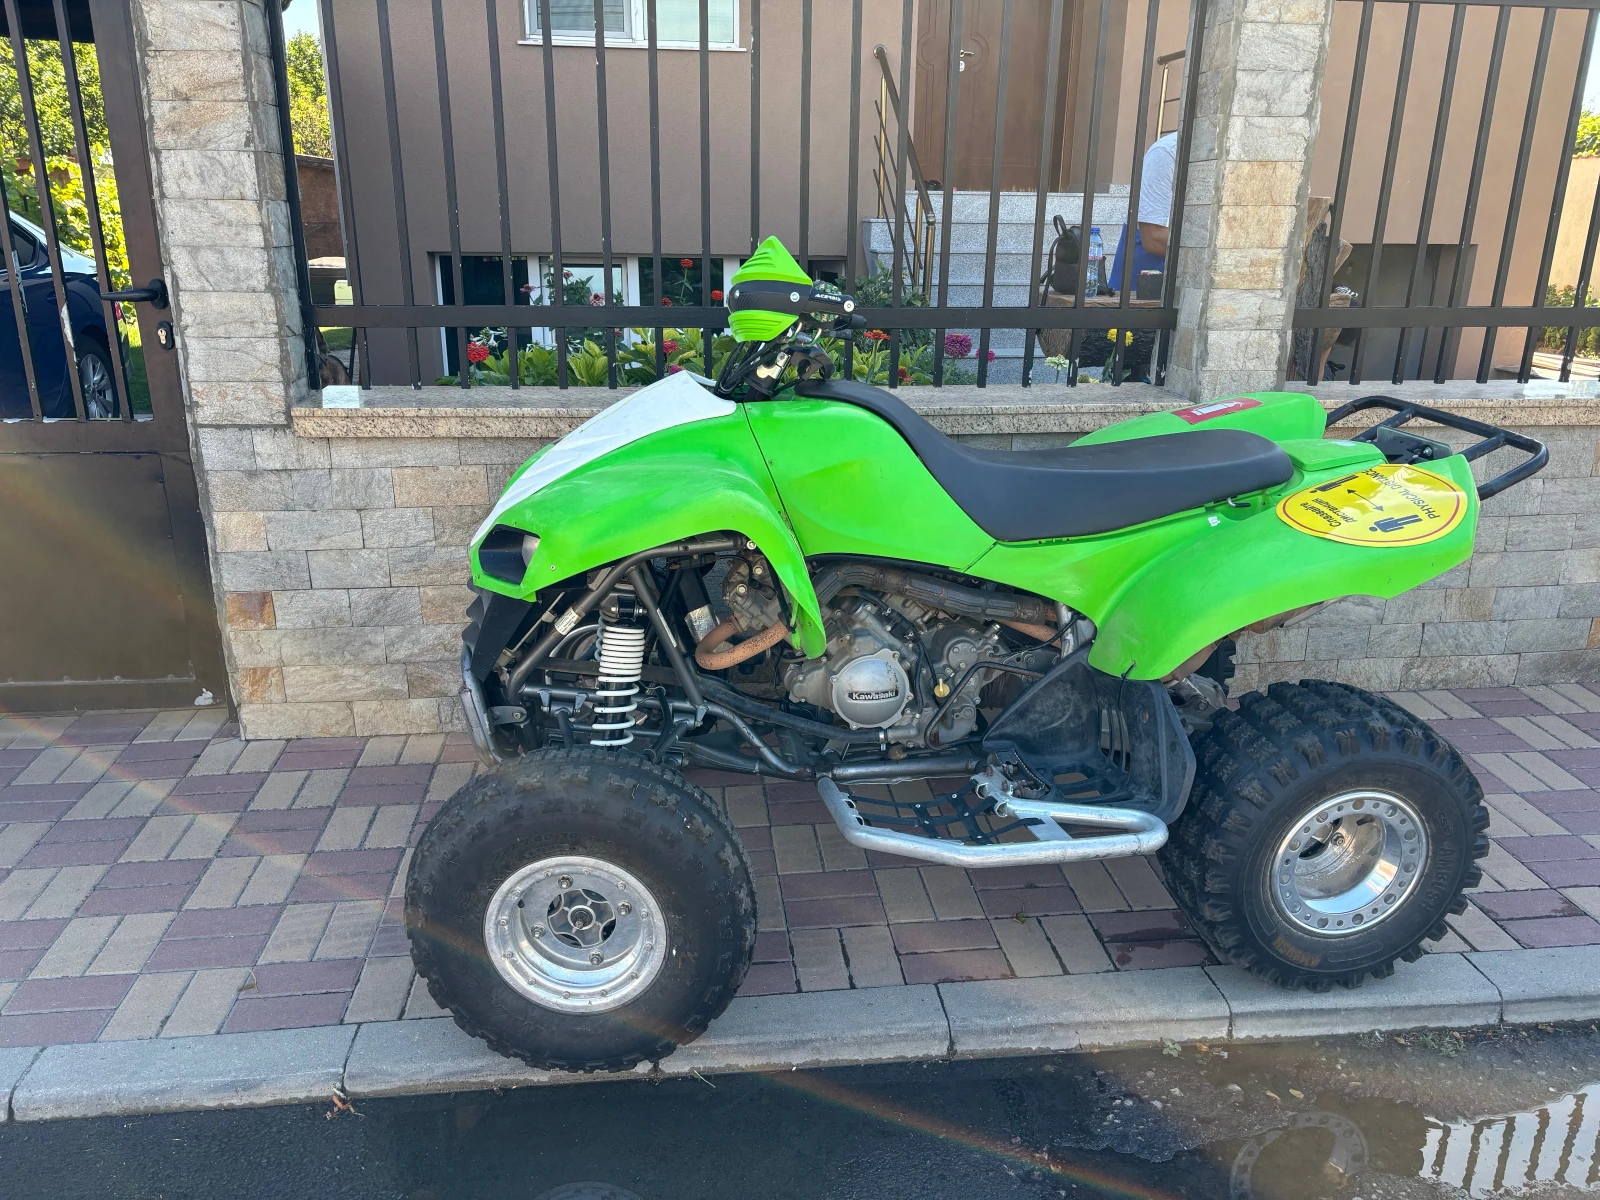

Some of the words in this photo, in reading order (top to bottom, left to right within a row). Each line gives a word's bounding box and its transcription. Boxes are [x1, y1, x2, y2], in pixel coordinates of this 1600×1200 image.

[1300, 502, 1341, 527] Спазвайте
[1399, 488, 1441, 519] PHYSICAL
[852, 690, 896, 700] Kawasaki
[1271, 935, 1321, 968] AMBUSH
